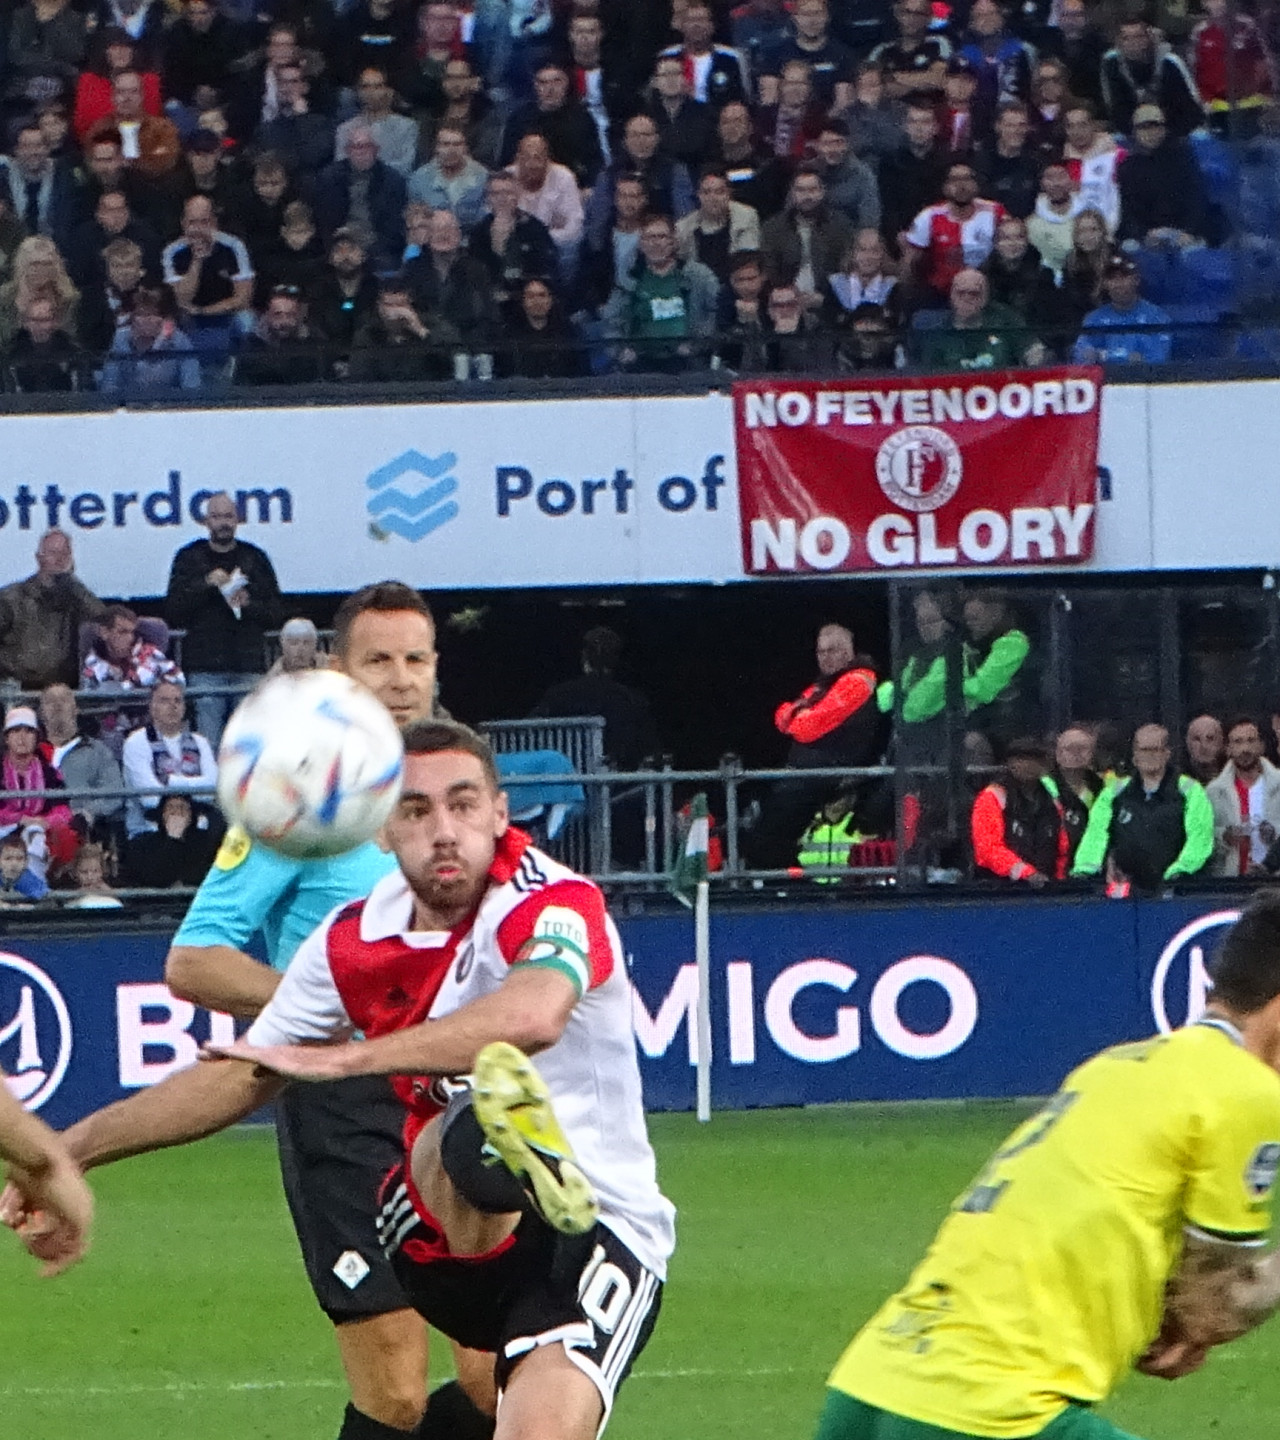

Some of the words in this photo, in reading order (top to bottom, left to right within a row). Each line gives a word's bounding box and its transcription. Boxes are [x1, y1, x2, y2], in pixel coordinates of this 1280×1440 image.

[745, 391, 812, 428] NO
[814, 379, 1096, 426] FEYENOORD
[495, 465, 635, 517] Port
[657, 454, 726, 512] of
[750, 515, 851, 571] NO
[867, 503, 1095, 566] GLORY
[629, 955, 979, 1066] MIGO
